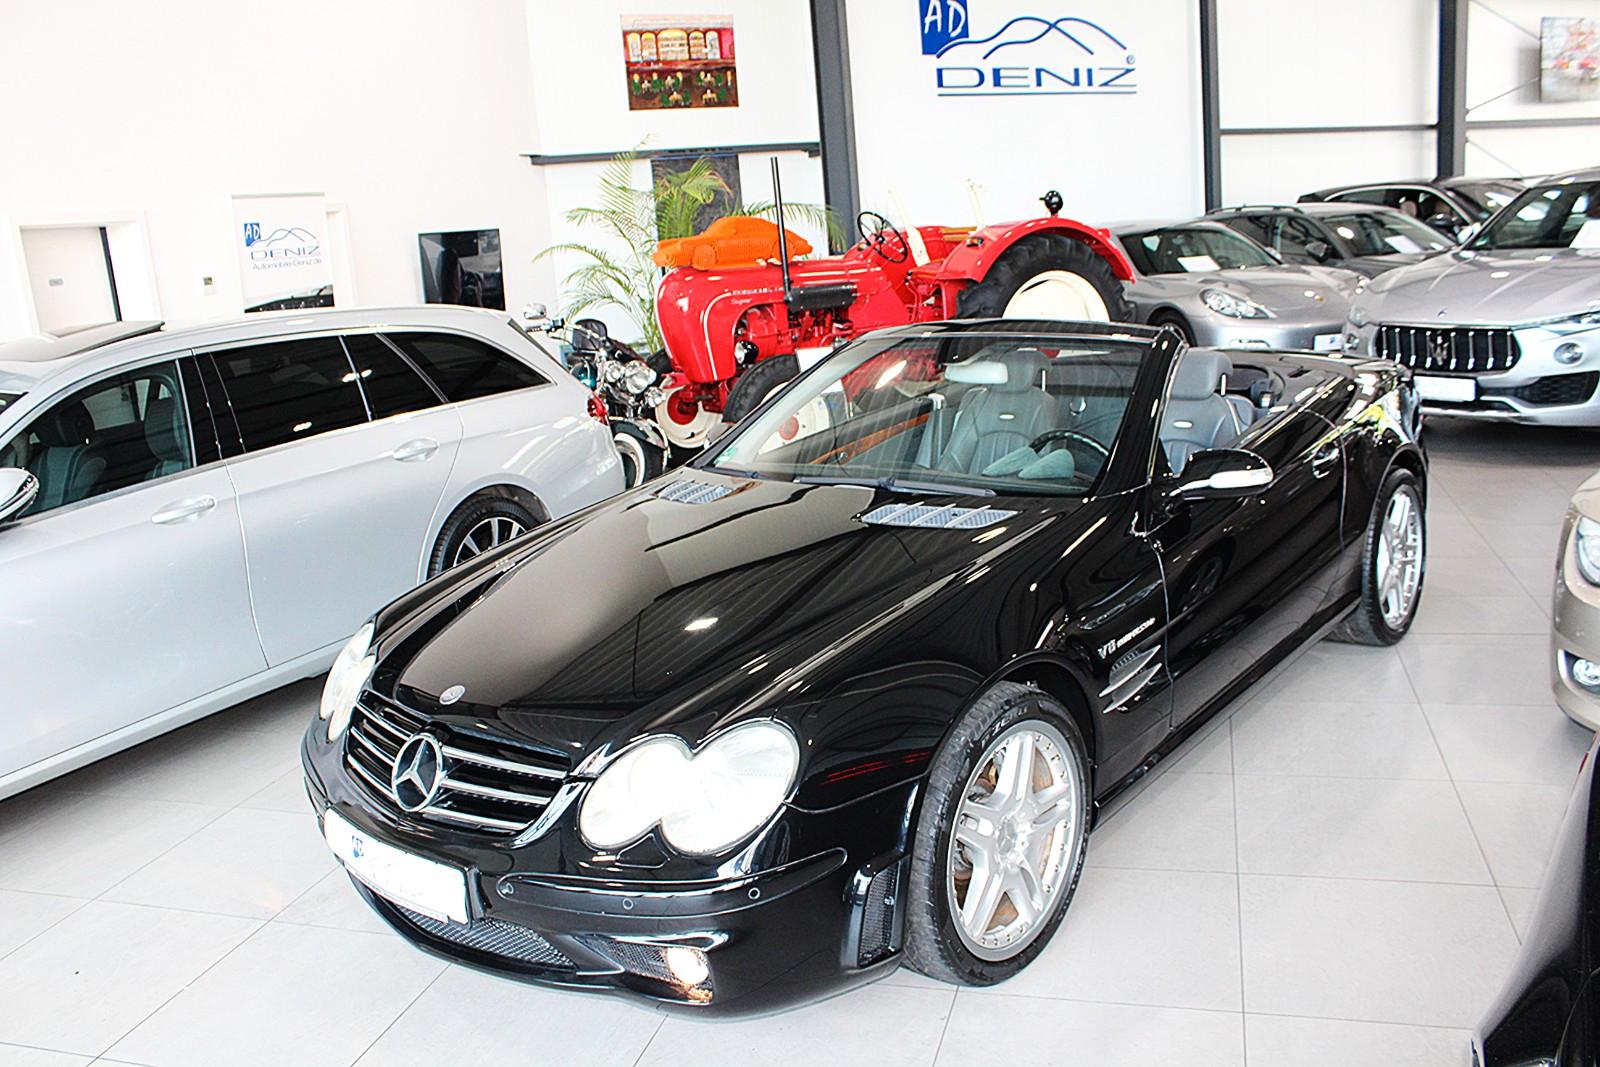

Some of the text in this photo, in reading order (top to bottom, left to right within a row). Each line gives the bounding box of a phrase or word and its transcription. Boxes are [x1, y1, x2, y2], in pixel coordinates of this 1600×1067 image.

[924, 0, 967, 38] AD
[936, 67, 1137, 88] DENIZ
[245, 223, 261, 241] AD
[250, 245, 320, 260] DENIZ
